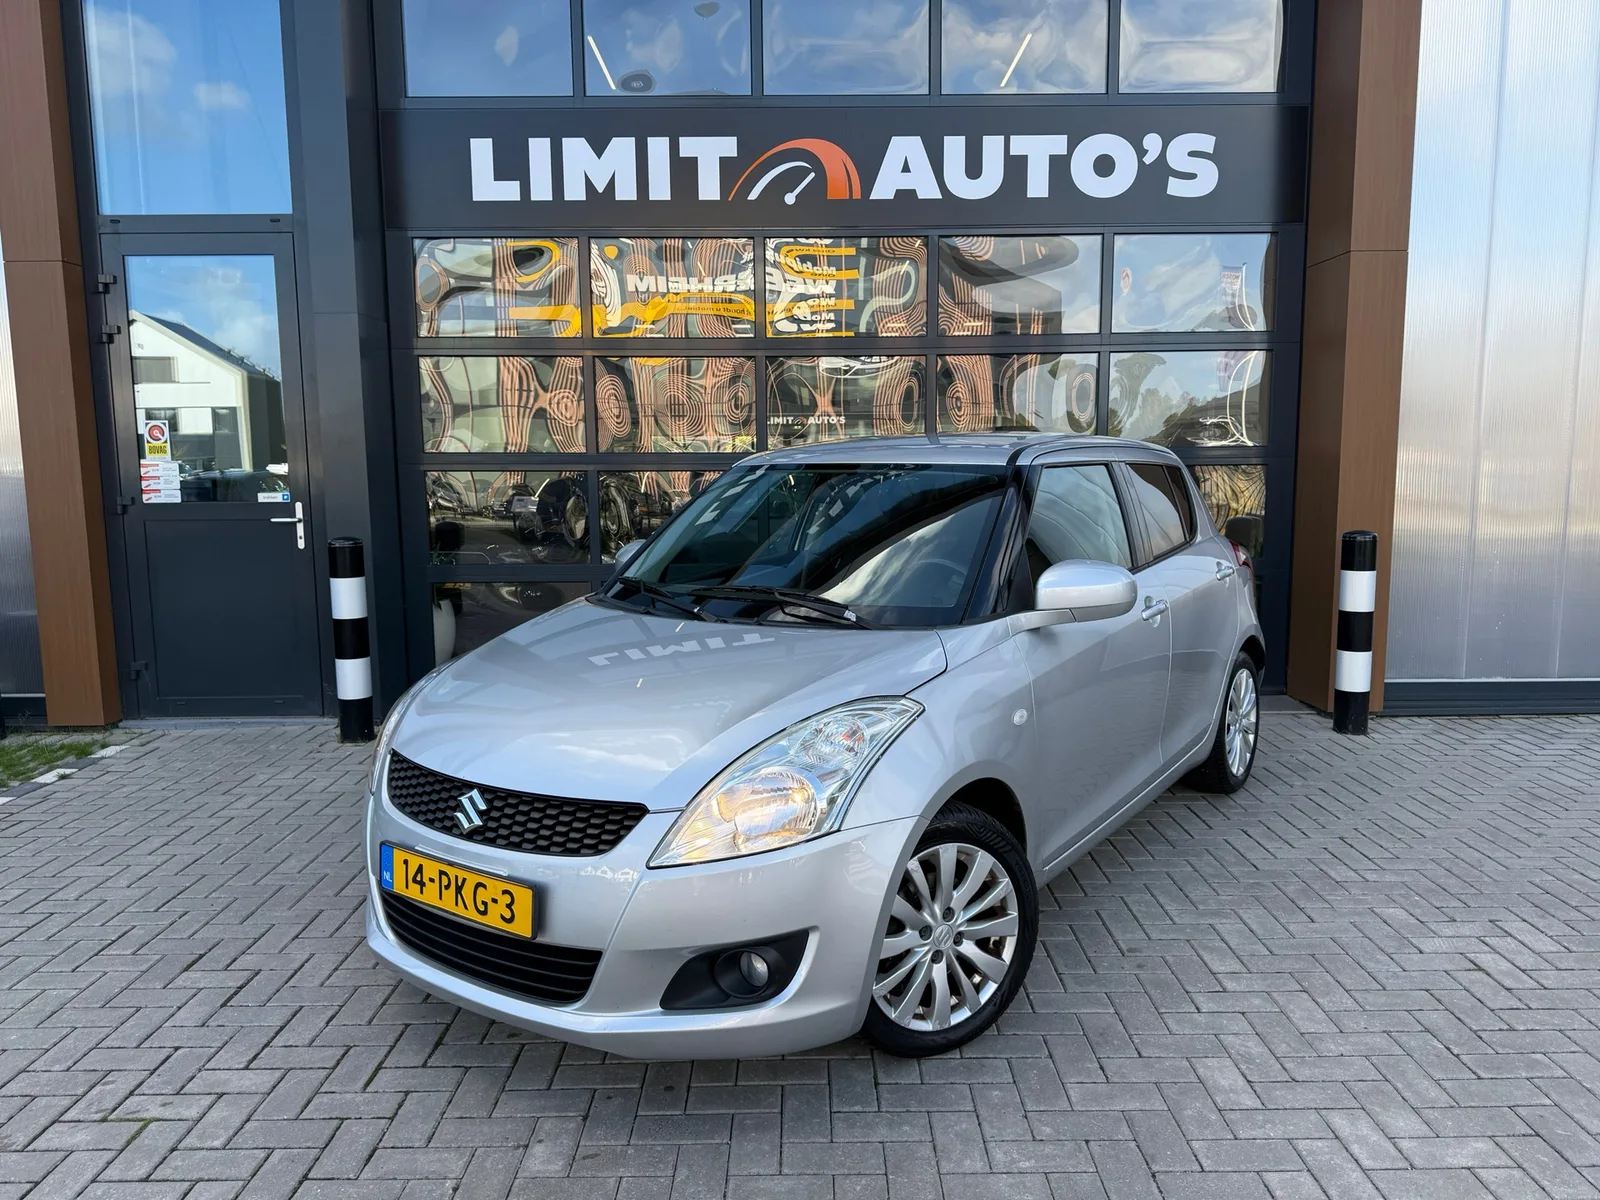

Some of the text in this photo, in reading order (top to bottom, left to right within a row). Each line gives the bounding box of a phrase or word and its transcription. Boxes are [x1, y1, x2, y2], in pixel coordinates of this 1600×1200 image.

[470, 132, 1219, 202] LIMIT AUTO'S
[148, 445, 168, 455] BOVAG
[383, 870, 393, 882] NL
[402, 858, 515, 924] 14-PKG-3
